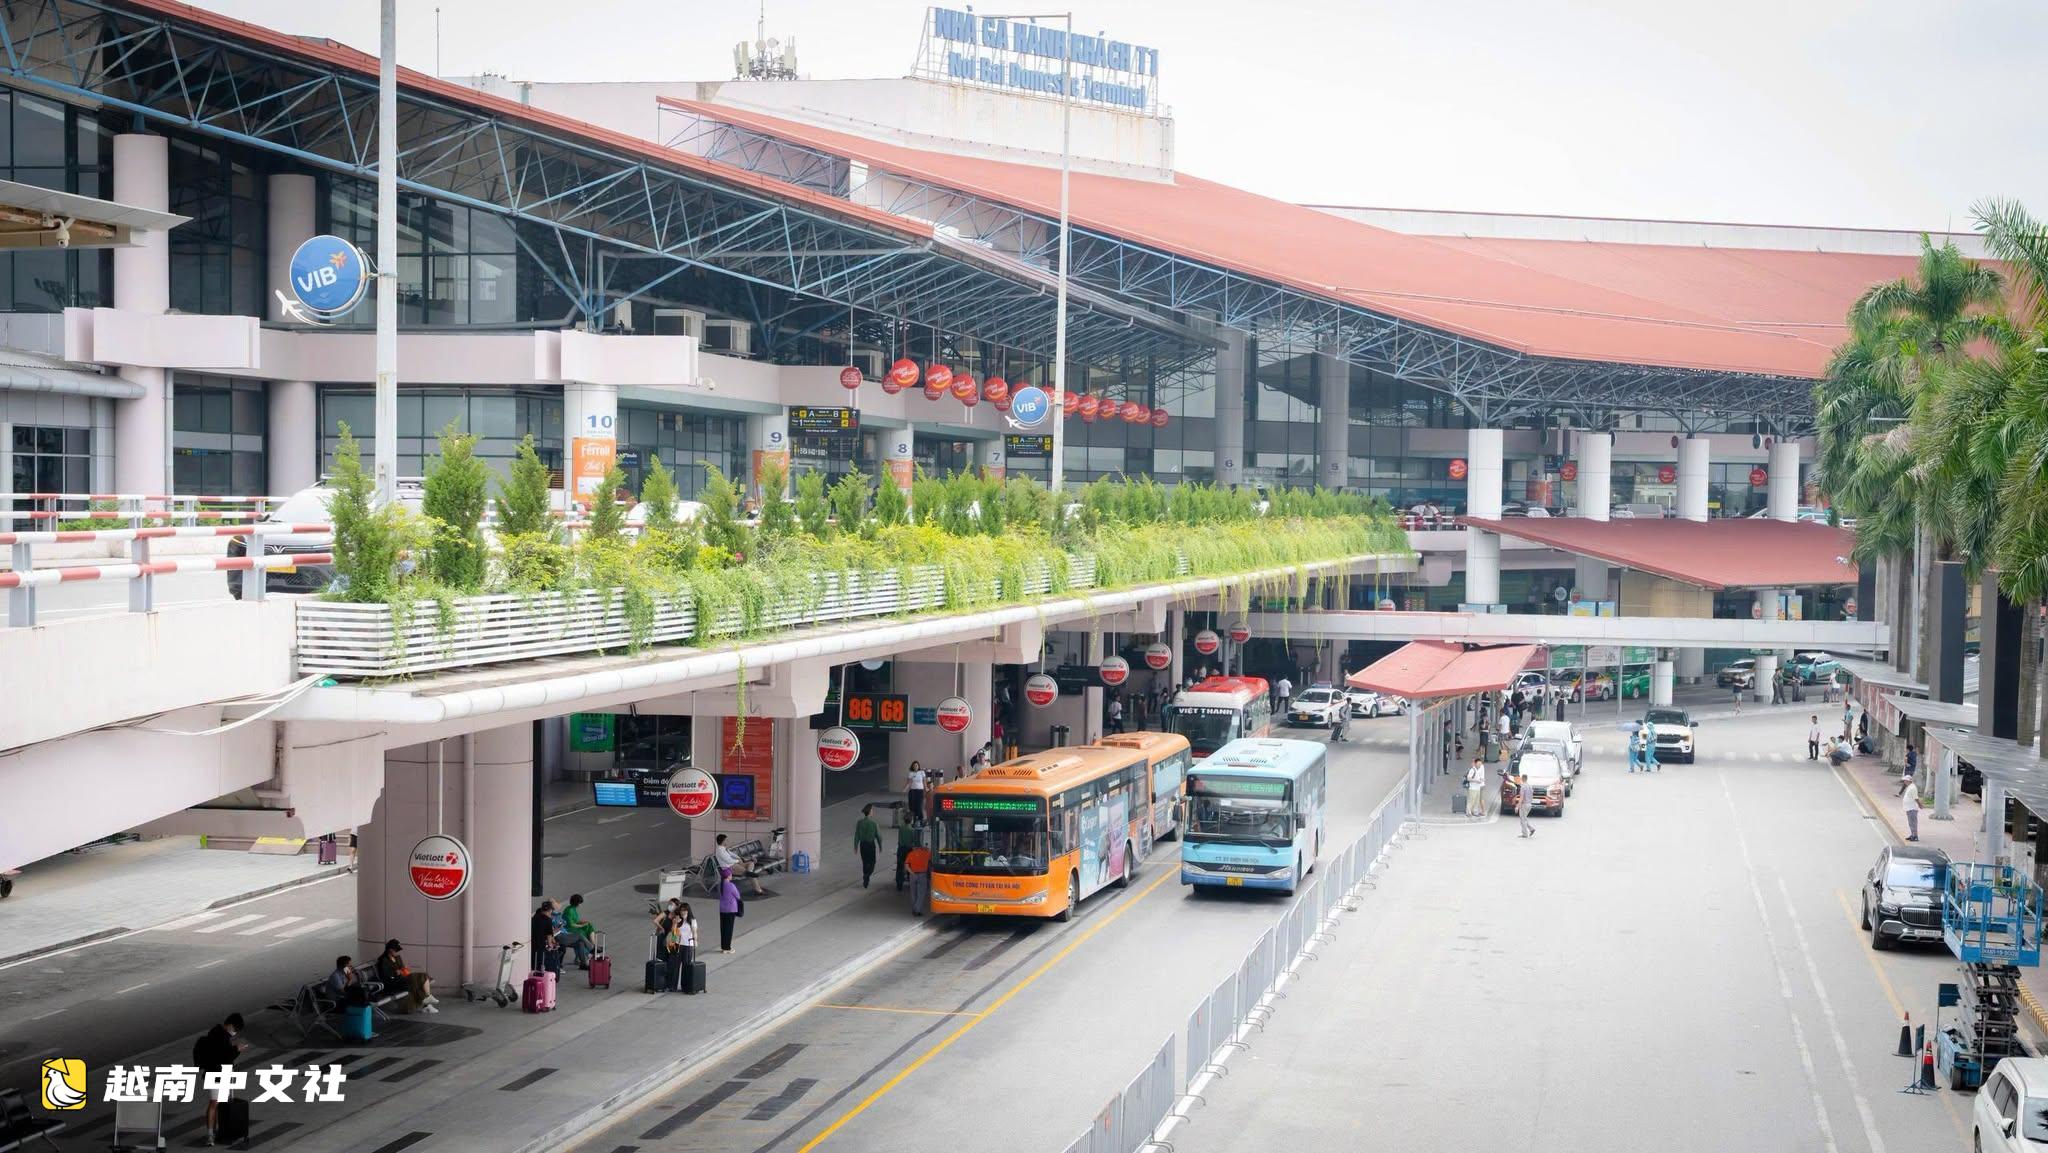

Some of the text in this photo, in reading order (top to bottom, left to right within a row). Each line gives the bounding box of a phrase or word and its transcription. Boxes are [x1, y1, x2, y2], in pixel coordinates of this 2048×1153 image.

[935, 5, 1159, 77] NHÀ GA HÀNH KHÁCH T1
[1083, 75, 1145, 108] Terminal
[297, 266, 337, 293] VIB
[1016, 402, 1036, 414] VIB
[587, 415, 613, 428] 10
[770, 431, 782, 443] 9
[898, 443, 908, 454] 8
[993, 452, 1000, 461] 7
[1225, 459, 1233, 468] 6
[849, 697, 873, 720] 86
[881, 699, 904, 722] 68
[415, 853, 444, 862] Vietlott
